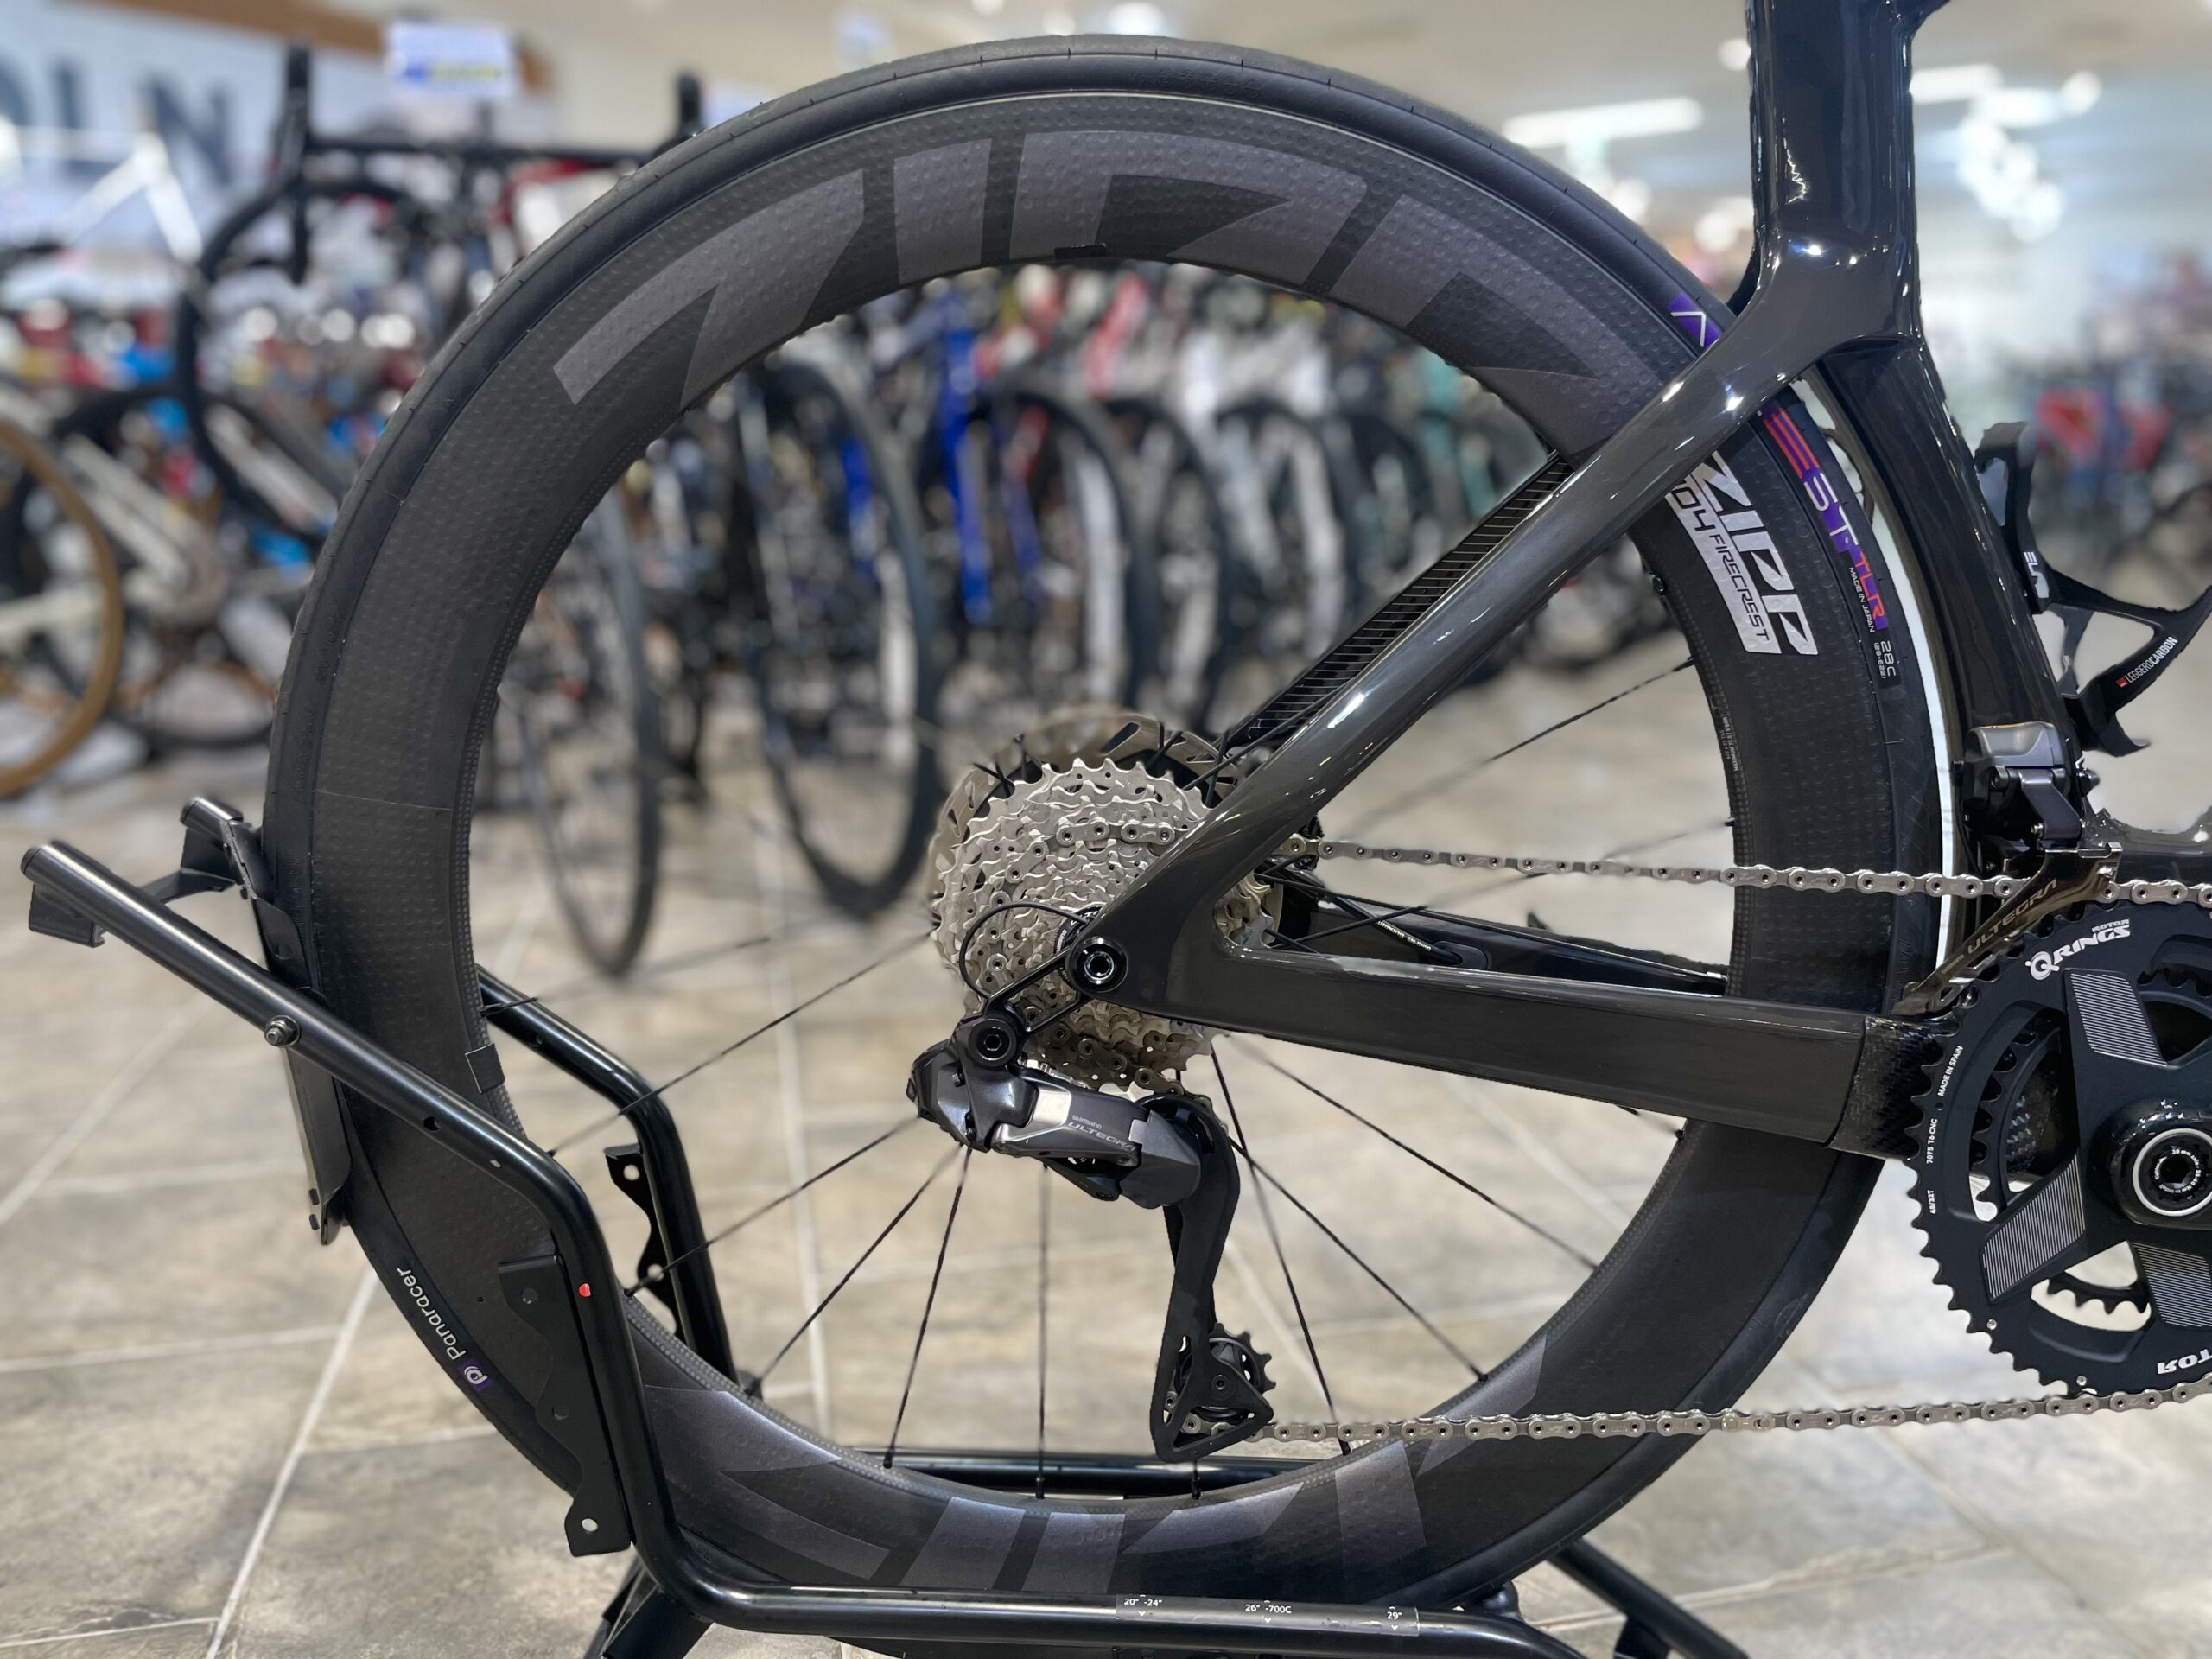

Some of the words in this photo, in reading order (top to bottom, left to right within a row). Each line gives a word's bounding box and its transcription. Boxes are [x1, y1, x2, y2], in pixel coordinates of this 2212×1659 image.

[1690, 450, 1818, 655] ZIPP
[1709, 533, 1770, 641] FIRECREST
[1848, 567, 1864, 593] MADE
[1862, 605, 1876, 632] JAPAN
[1855, 552, 1886, 620] TLR
[1880, 640, 1897, 677] 28C
[1967, 878, 2057, 954] ULTEGRA
[2091, 918, 2129, 932] ROTOR
[1937, 1074, 1951, 1096] MADE
[1948, 1045, 1964, 1066] SPAIN
[1068, 1122, 1136, 1153] ULTEGRA
[1927, 1135, 1936, 1145] T6
[1929, 1118, 1938, 1135] CNC
[1926, 1146, 1935, 1165] 7075
[397, 1268, 467, 1360] Panaracer
